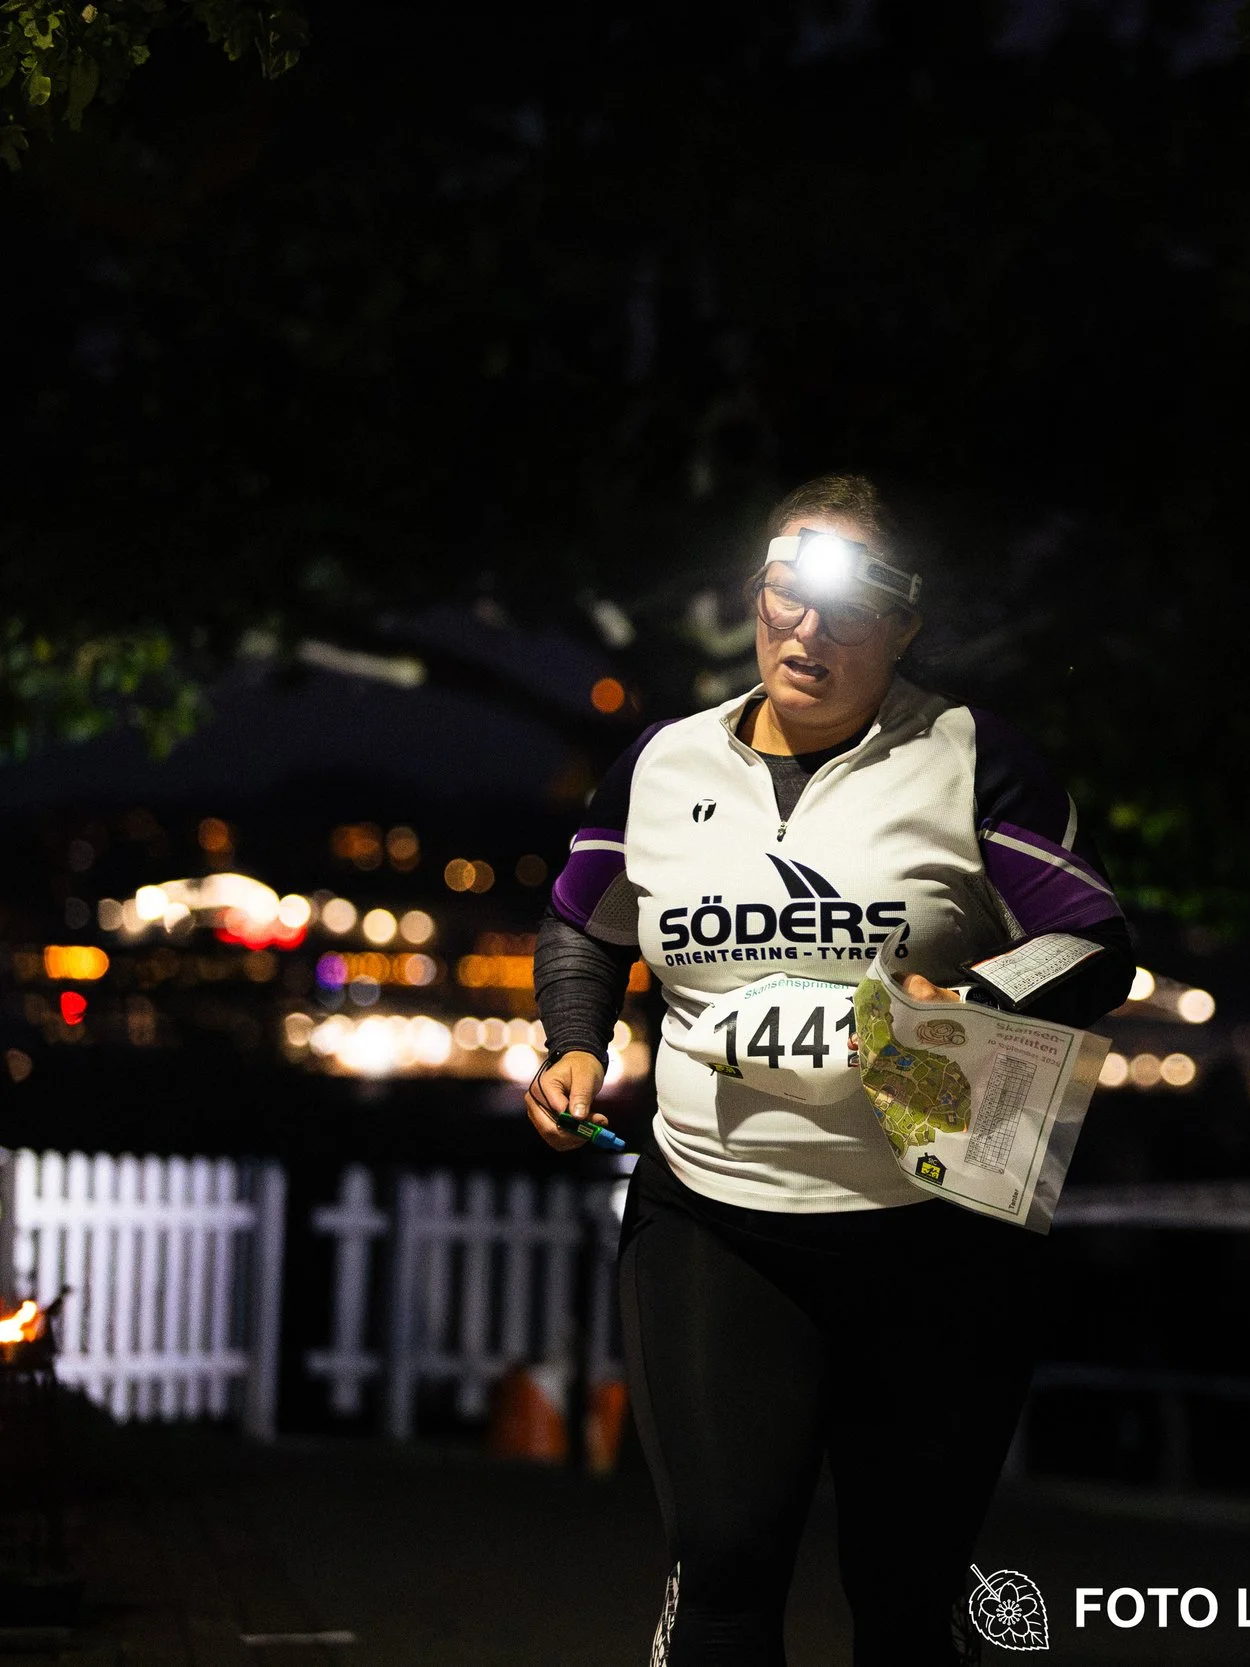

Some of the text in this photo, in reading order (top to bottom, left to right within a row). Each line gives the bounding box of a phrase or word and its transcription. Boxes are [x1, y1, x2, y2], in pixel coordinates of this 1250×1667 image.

[659, 895, 910, 951] SÖDERS
[665, 946, 797, 967] ORIENTERING
[817, 944, 909, 960] TYREÖ
[744, 978, 849, 1000] Skansensprinten
